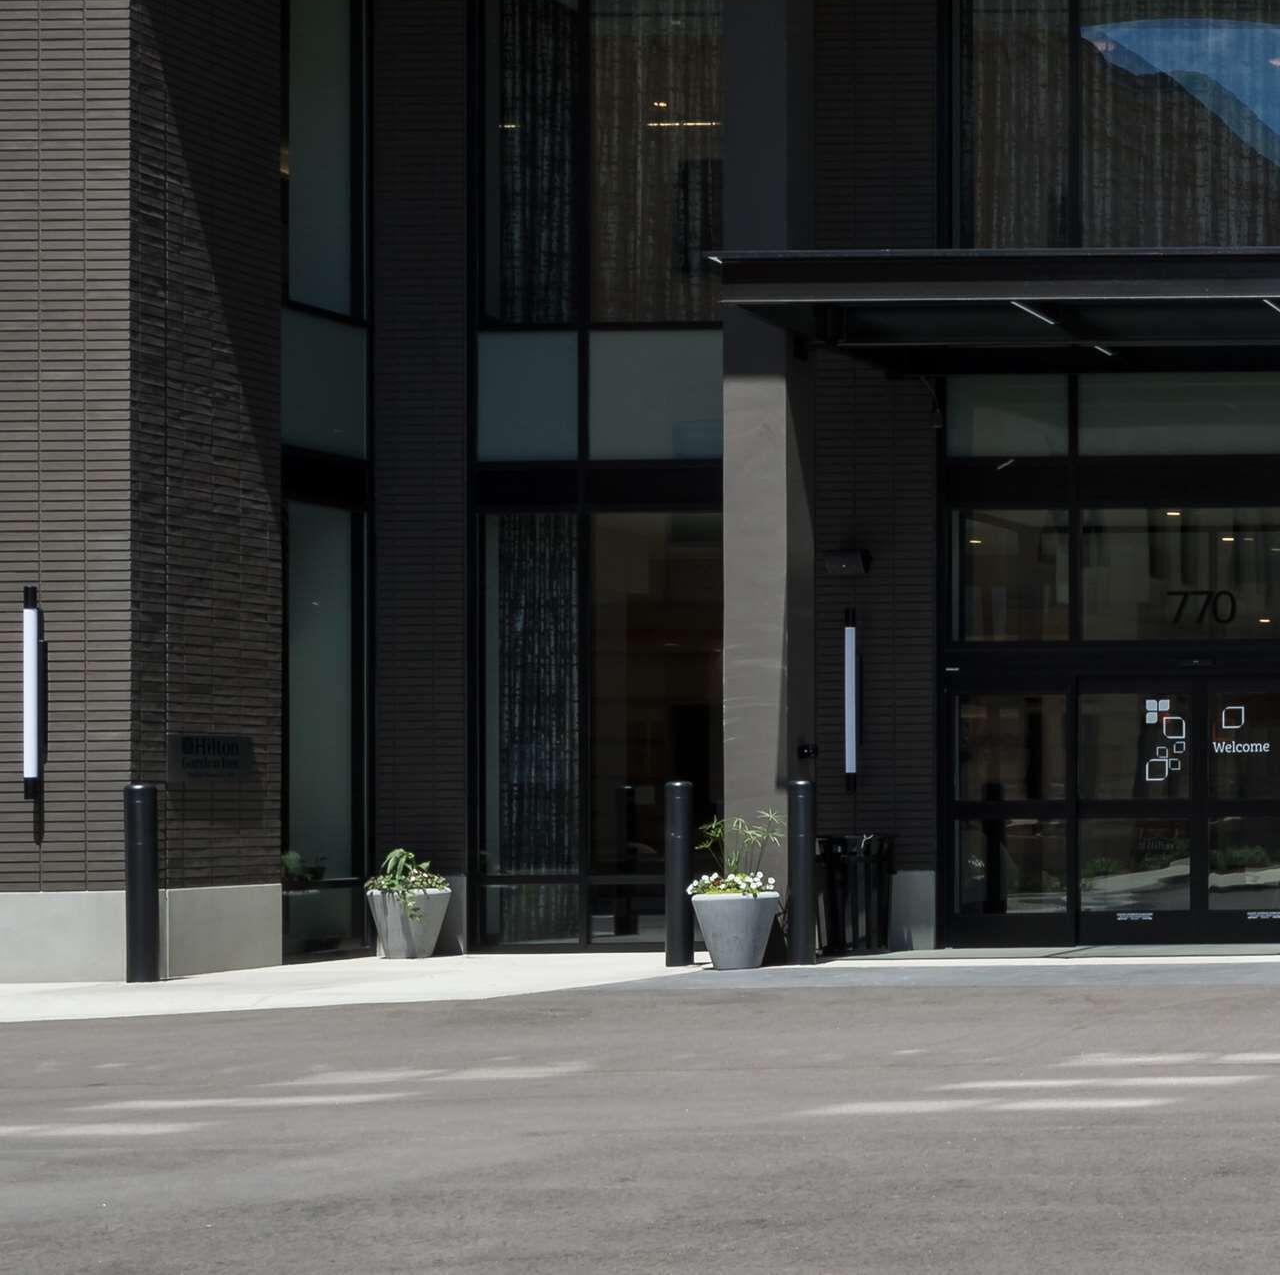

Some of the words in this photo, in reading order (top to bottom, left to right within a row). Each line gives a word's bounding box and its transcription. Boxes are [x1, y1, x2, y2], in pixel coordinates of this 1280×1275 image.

[1166, 590, 1237, 623] 770
[195, 737, 239, 756] Hilton
[1212, 740, 1271, 754] Welcome
